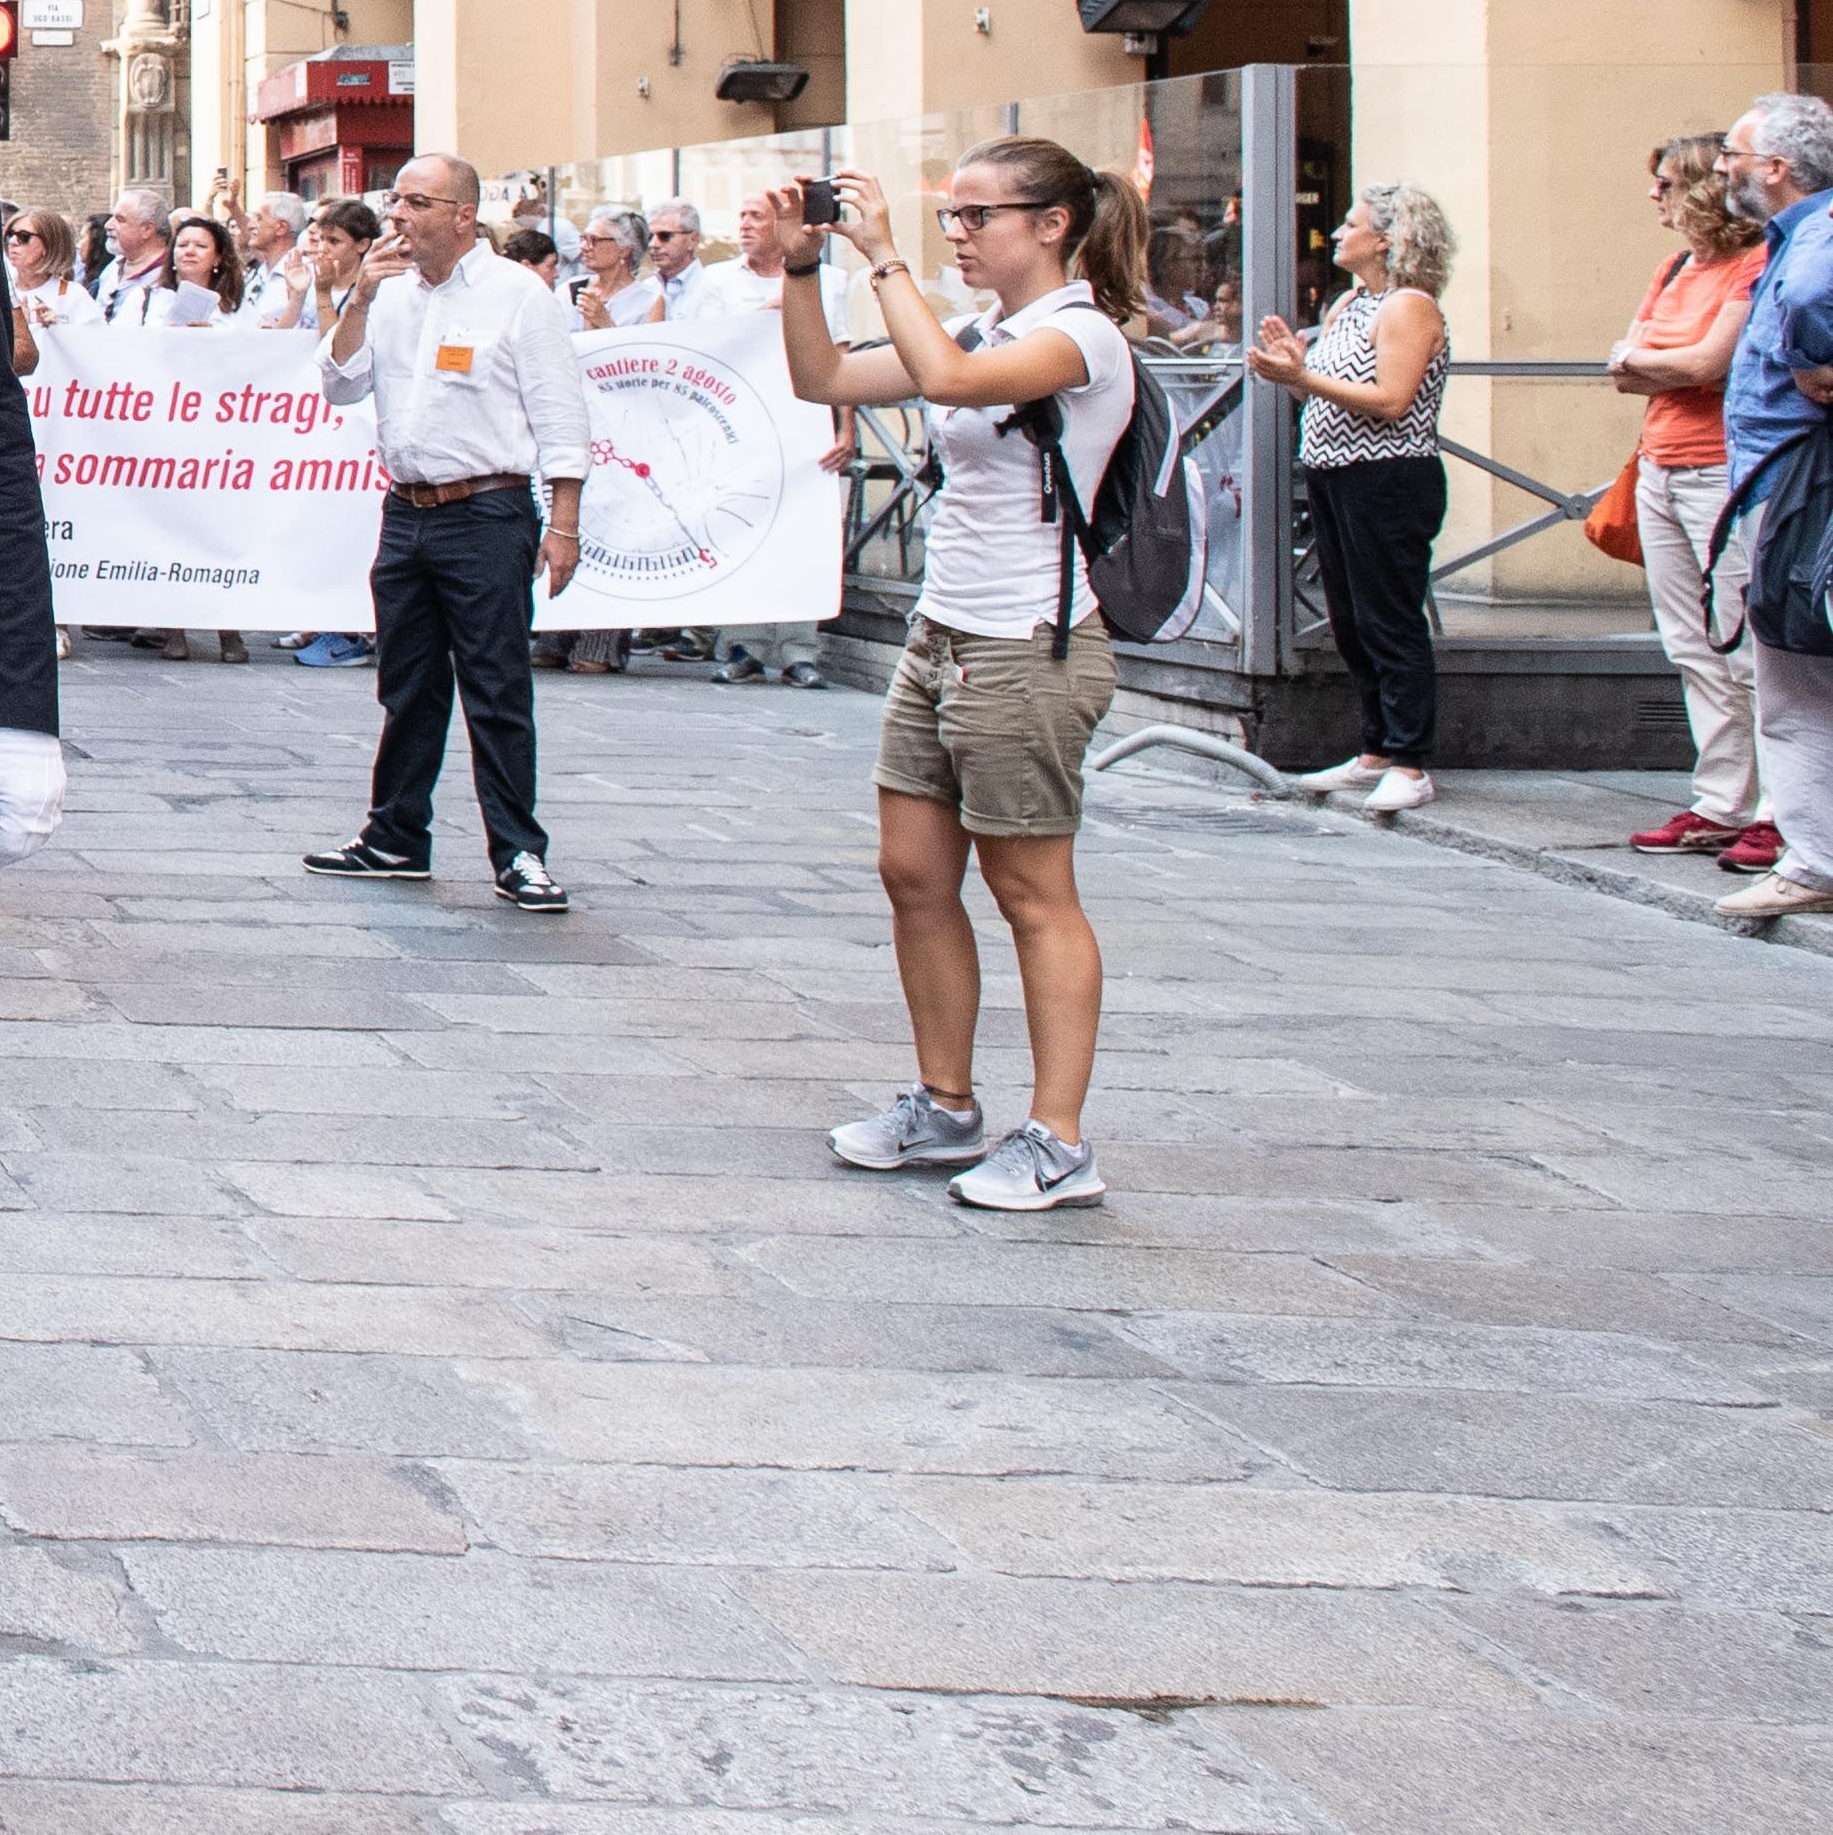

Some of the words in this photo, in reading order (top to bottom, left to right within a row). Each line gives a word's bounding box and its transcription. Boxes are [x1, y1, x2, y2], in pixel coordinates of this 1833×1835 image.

[64, 379, 154, 422] tutte
[169, 381, 202, 423] le
[585, 357, 660, 381] cantiere
[665, 359, 679, 376] 2
[682, 364, 737, 406] agosto
[651, 379, 670, 391] per
[55, 449, 255, 491] sommaria
[95, 560, 261, 589] Emilia-Romagna
